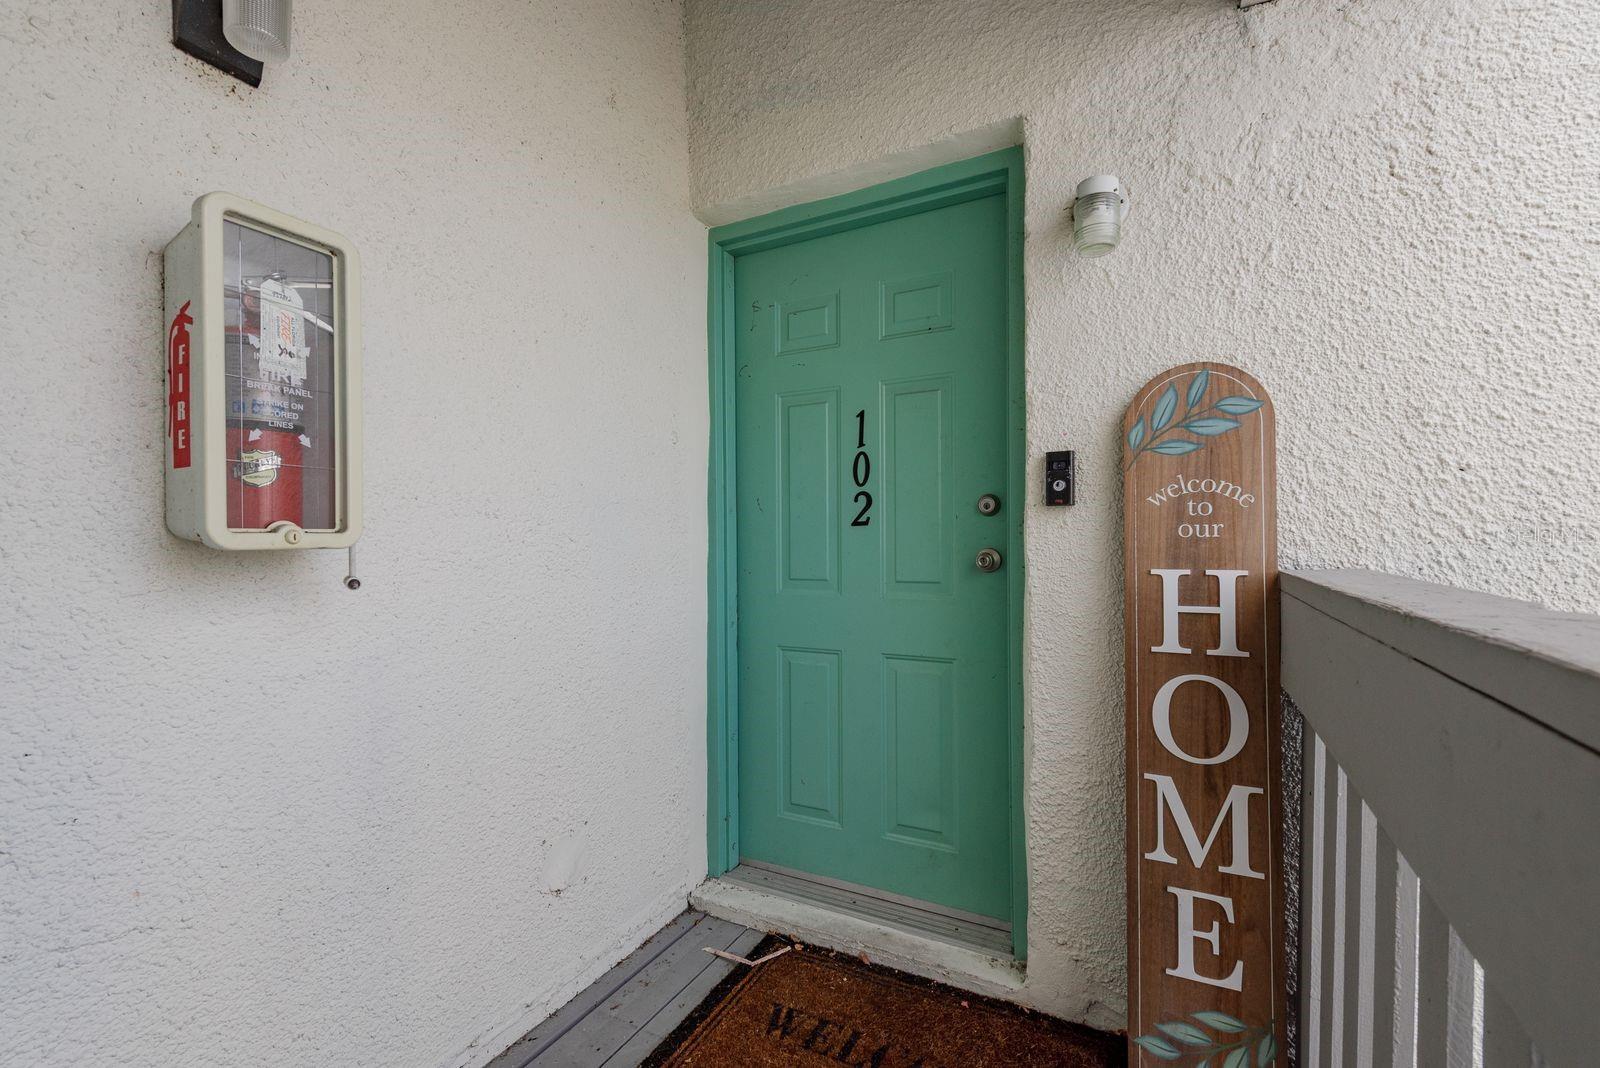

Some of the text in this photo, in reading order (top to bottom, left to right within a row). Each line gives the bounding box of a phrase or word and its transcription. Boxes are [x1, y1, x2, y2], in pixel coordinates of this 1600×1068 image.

[178, 344, 186, 449] FIRE
[283, 386, 313, 398] PANEL
[291, 402, 304, 410] ON
[268, 420, 294, 429] LINES
[851, 409, 873, 527] 102
[1146, 474, 1255, 508] welcome
[1187, 499, 1213, 516] to
[1178, 522, 1225, 538] our
[1143, 568, 1265, 992] HOME
